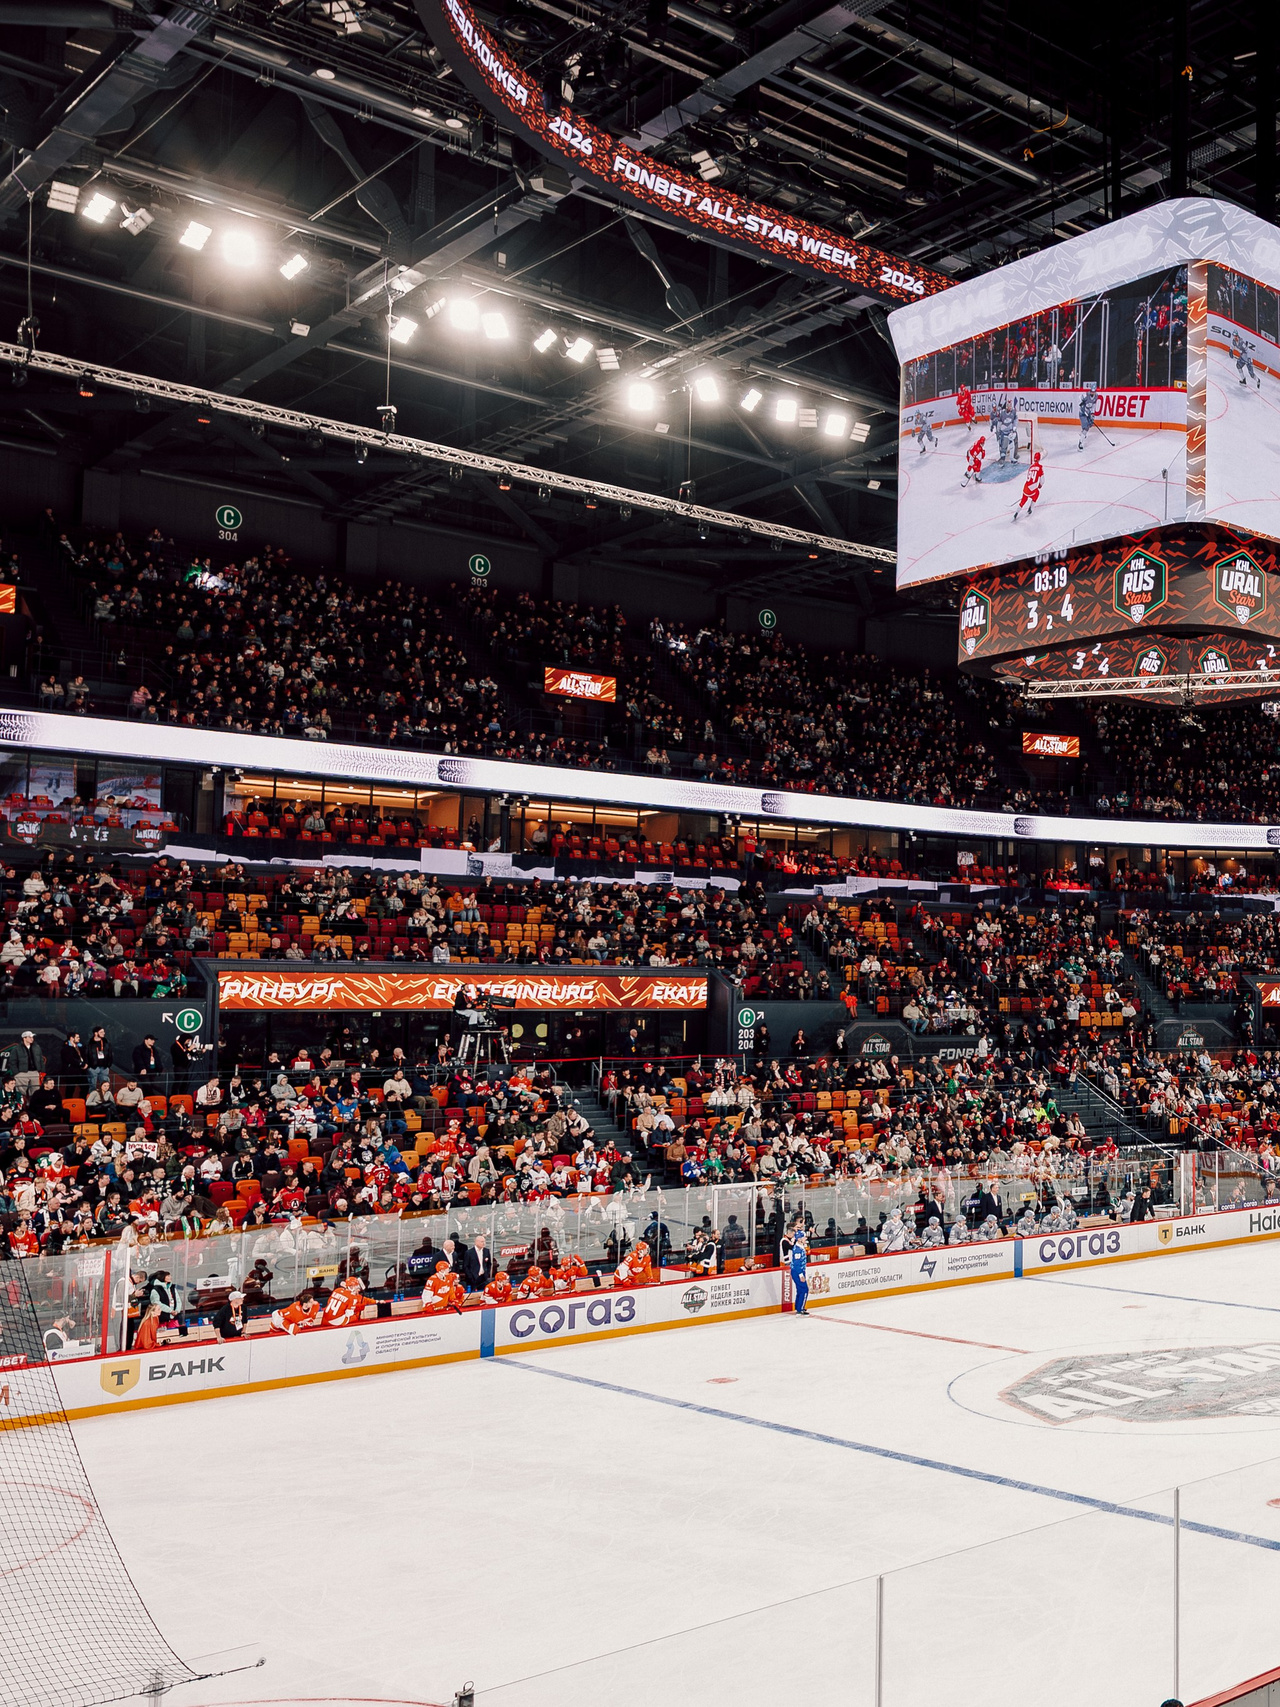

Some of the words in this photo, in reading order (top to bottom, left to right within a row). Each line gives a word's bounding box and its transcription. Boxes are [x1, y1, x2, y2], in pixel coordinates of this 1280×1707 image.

[472, 32, 528, 107] ХОККЕЯ
[549, 116, 593, 156] 2026
[612, 155, 698, 206] FONBET
[697, 196, 799, 250] ALL-STAR
[801, 236, 858, 270] WEEK
[1073, 225, 1153, 283] 2026
[879, 266, 925, 296] 2026
[930, 281, 1006, 338] GAME
[1019, 397, 1073, 414] Ростелеком
[224, 509, 234, 525] C
[218, 530, 238, 542] 304
[475, 558, 484, 572] C
[1130, 557, 1145, 571] KHL
[1236, 559, 1251, 573] KHL
[471, 576, 487, 587] 303
[1034, 567, 1068, 593] 03:19
[1122, 569, 1156, 595] RUS
[1221, 570, 1261, 597] URAL
[1124, 591, 1152, 606] Stars
[1228, 589, 1255, 607] Stars
[1027, 600, 1038, 629] 3
[1061, 594, 1073, 621] 4
[763, 612, 771, 625] C
[961, 605, 986, 630] URAL
[1046, 615, 1053, 630] 2
[761, 629, 774, 638] 302
[1092, 643, 1101, 655] 2
[1267, 644, 1277, 657] 2
[1072, 652, 1086, 670] 3
[1098, 657, 1109, 675] 4
[1139, 657, 1161, 672] RUS
[1203, 658, 1228, 673] URAL
[183, 1012, 195, 1029] C
[743, 1012, 750, 1023] C
[738, 1029, 755, 1039] 203
[738, 1040, 754, 1050] 204
[1175, 1223, 1206, 1238] БАНК
[501, 1246, 528, 1256] FONBET
[948, 1256, 967, 1265] Центр
[968, 1252, 1004, 1263] спортивных
[838, 1267, 881, 1279] ПРАВИТЕЛЬСТВО
[948, 1260, 989, 1271] мероприятий
[711, 1283, 731, 1292] FONBET
[838, 1277, 879, 1289] СВЕРДЛОВСКОЙ
[879, 1273, 903, 1283] ОБЛАСТИ
[711, 1291, 732, 1300] НЕДЕЛЯ
[733, 1289, 750, 1297] ЗВЕЗД
[711, 1299, 732, 1308] ХОККЕЯ
[149, 1356, 226, 1381] БАНК
[1041, 1352, 1182, 1386] FONBET
